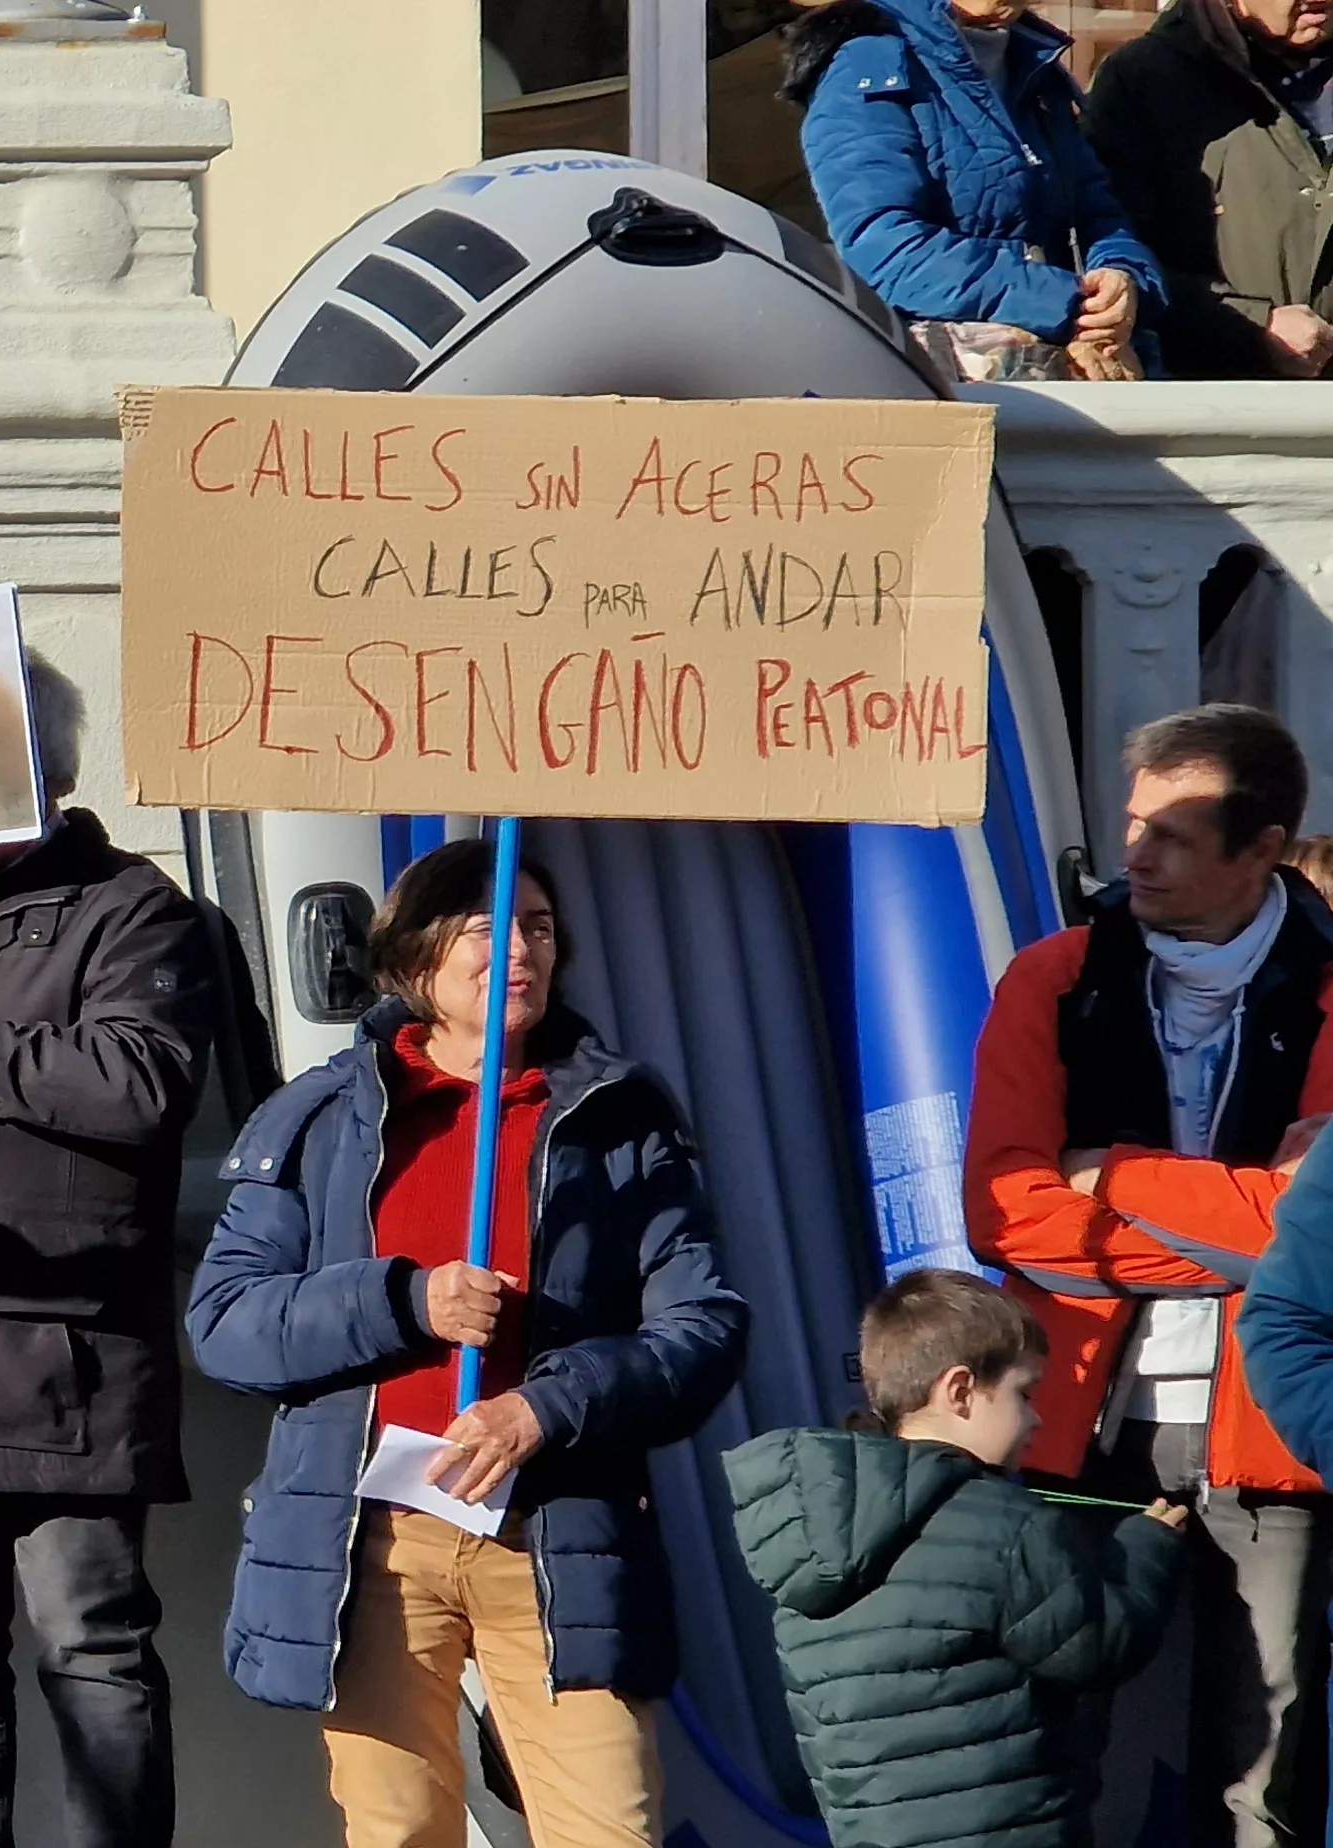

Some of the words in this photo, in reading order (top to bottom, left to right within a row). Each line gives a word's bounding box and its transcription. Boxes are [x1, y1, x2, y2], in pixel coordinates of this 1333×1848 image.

[190, 417, 468, 512] CALLES
[515, 444, 581, 514] SIN
[616, 436, 886, 522] ACERAS
[313, 535, 558, 619] CALLES
[583, 580, 648, 630] PARA
[689, 543, 908, 631] ANDAR
[179, 630, 707, 776] DESENGAÑO
[756, 658, 988, 766] PEATONAL
